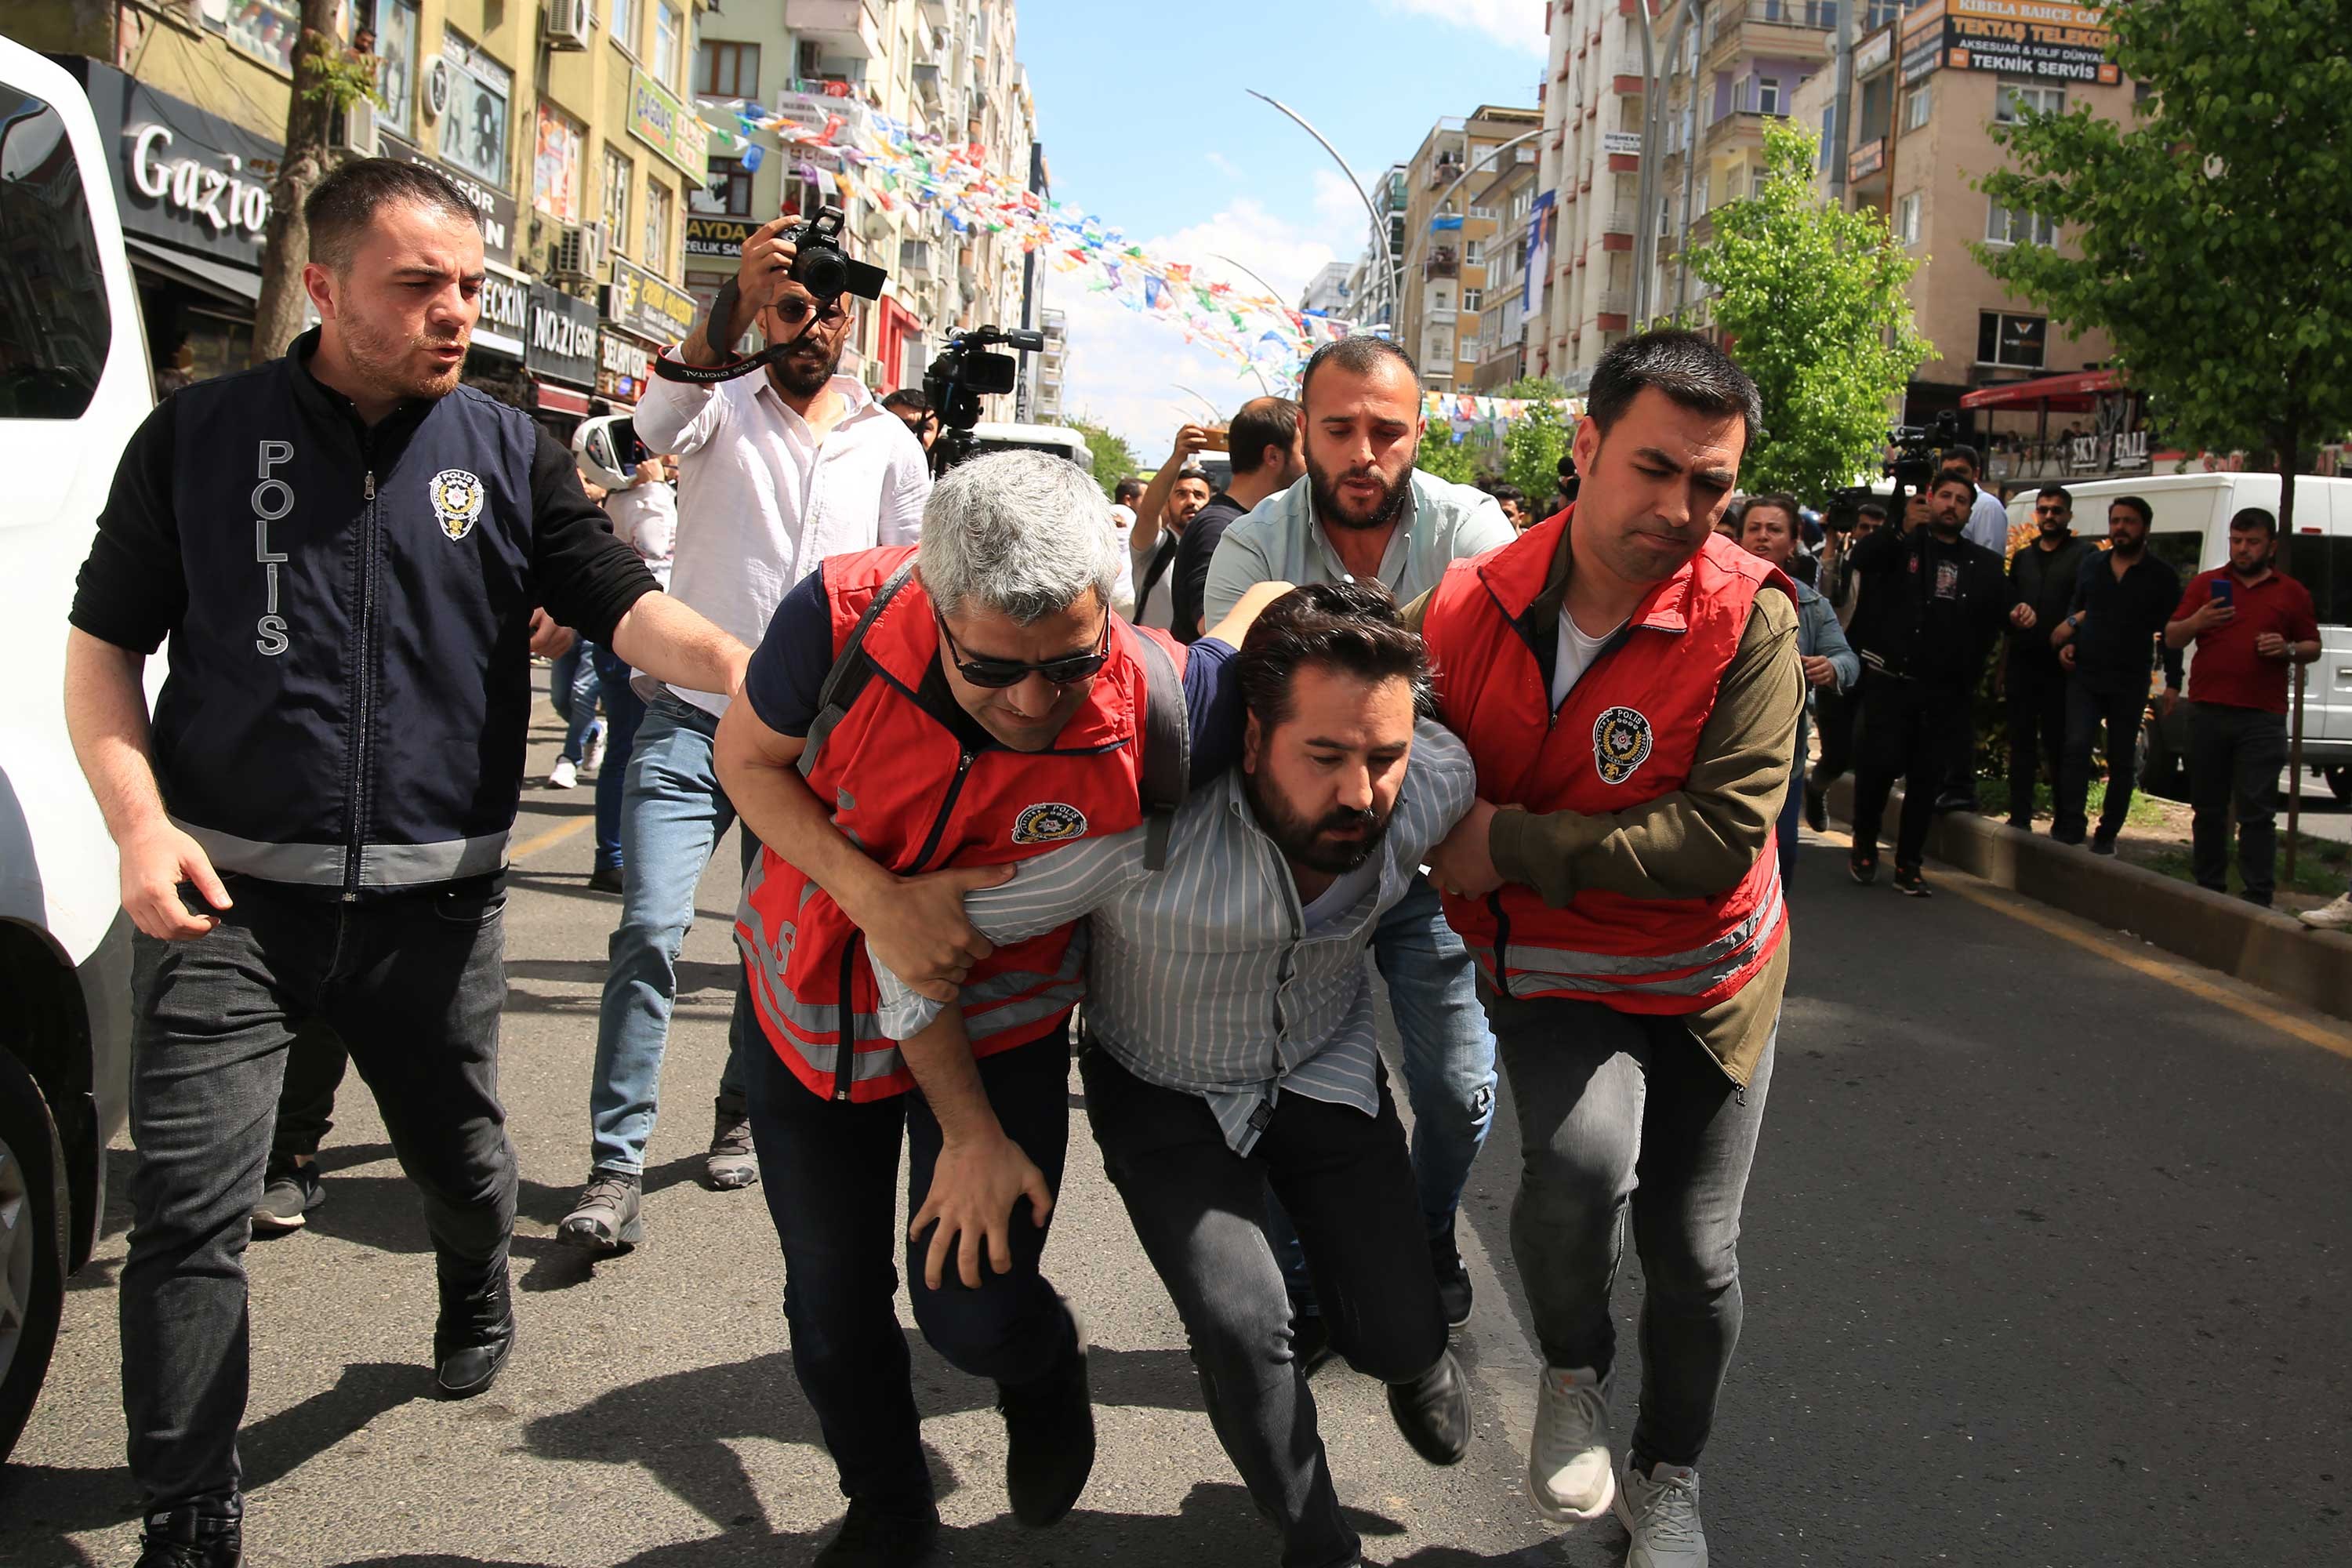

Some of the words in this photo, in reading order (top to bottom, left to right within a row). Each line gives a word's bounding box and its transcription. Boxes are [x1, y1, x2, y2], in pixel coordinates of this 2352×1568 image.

[1959, 39, 2020, 54] AKSESUAR
[1973, 53, 2034, 73] TEKNİK
[2038, 60, 2096, 80] SERVİS
[133, 125, 274, 231] Gazio
[479, 277, 527, 333] EÇKİN
[2072, 436, 2098, 462] SKY
[2115, 430, 2149, 459] FALL
